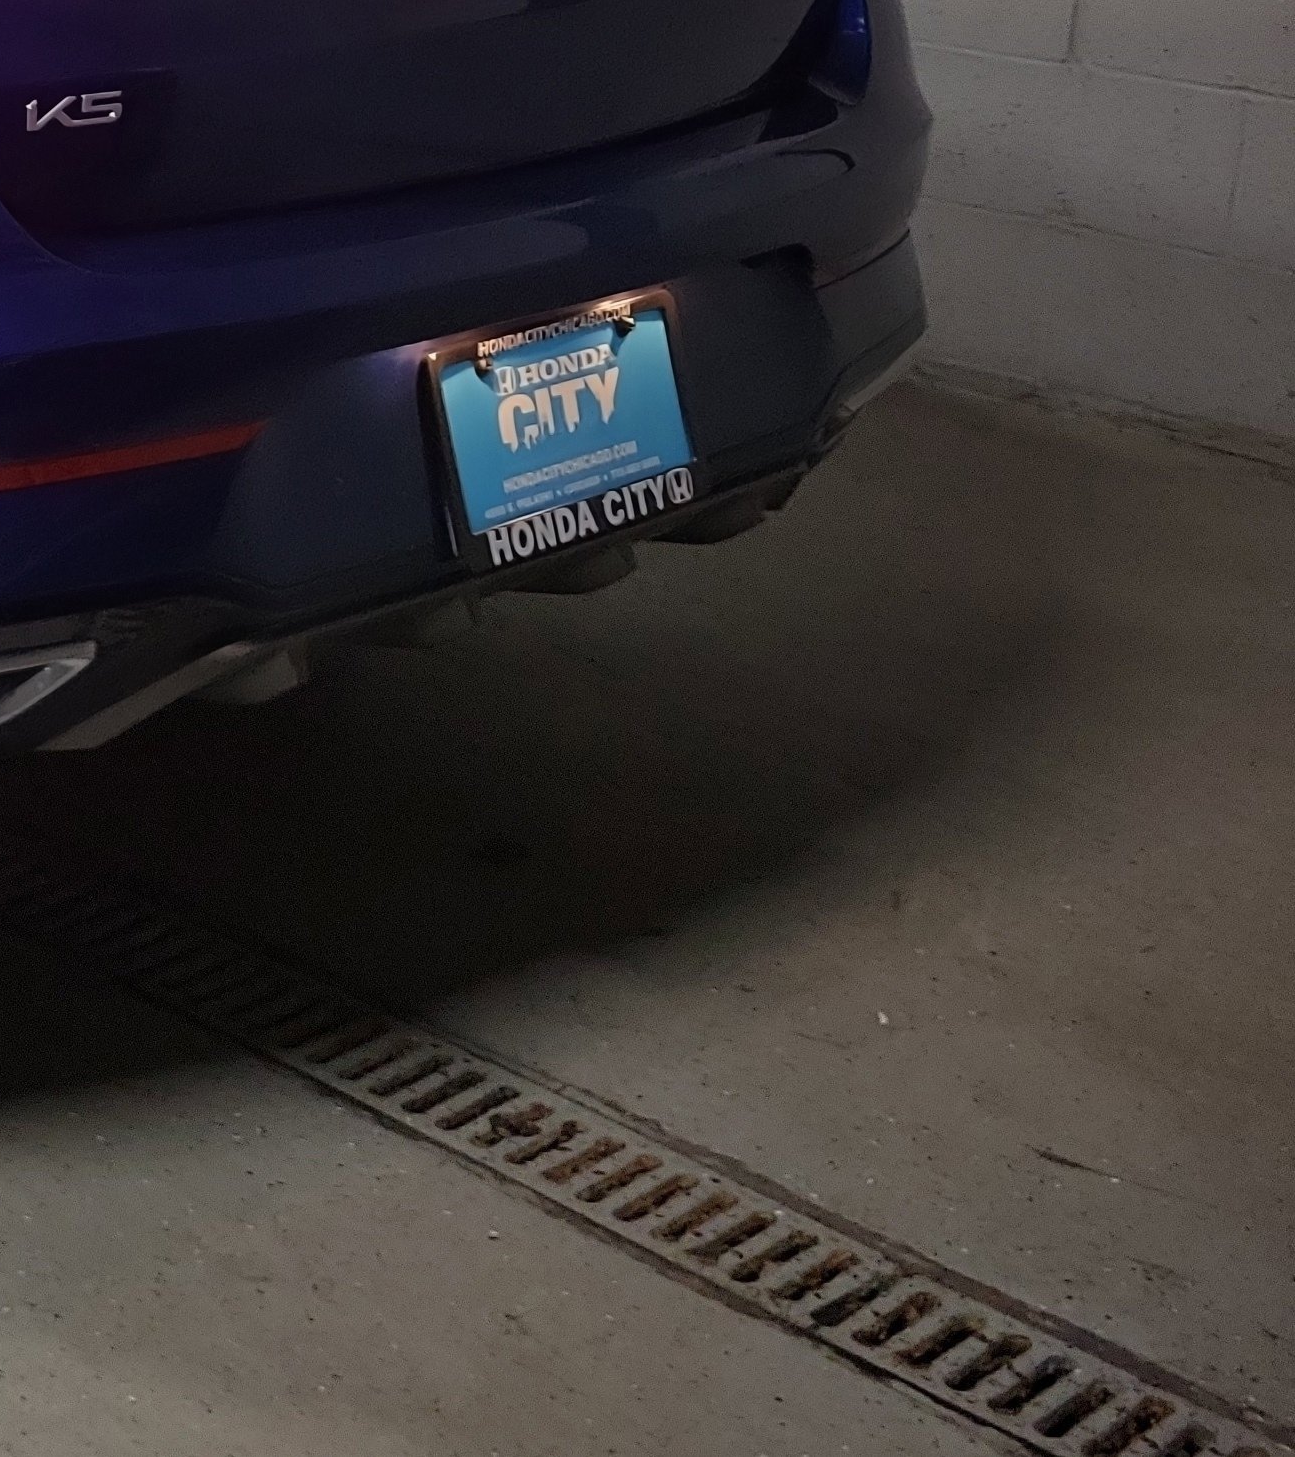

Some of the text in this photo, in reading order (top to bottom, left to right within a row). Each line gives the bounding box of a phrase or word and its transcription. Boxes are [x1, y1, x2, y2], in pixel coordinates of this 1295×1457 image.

[26, 90, 123, 131] K5
[519, 344, 616, 387] HONDA
[498, 366, 619, 454] CITY
[486, 501, 600, 566] HONDA
[602, 474, 665, 526] CITY
